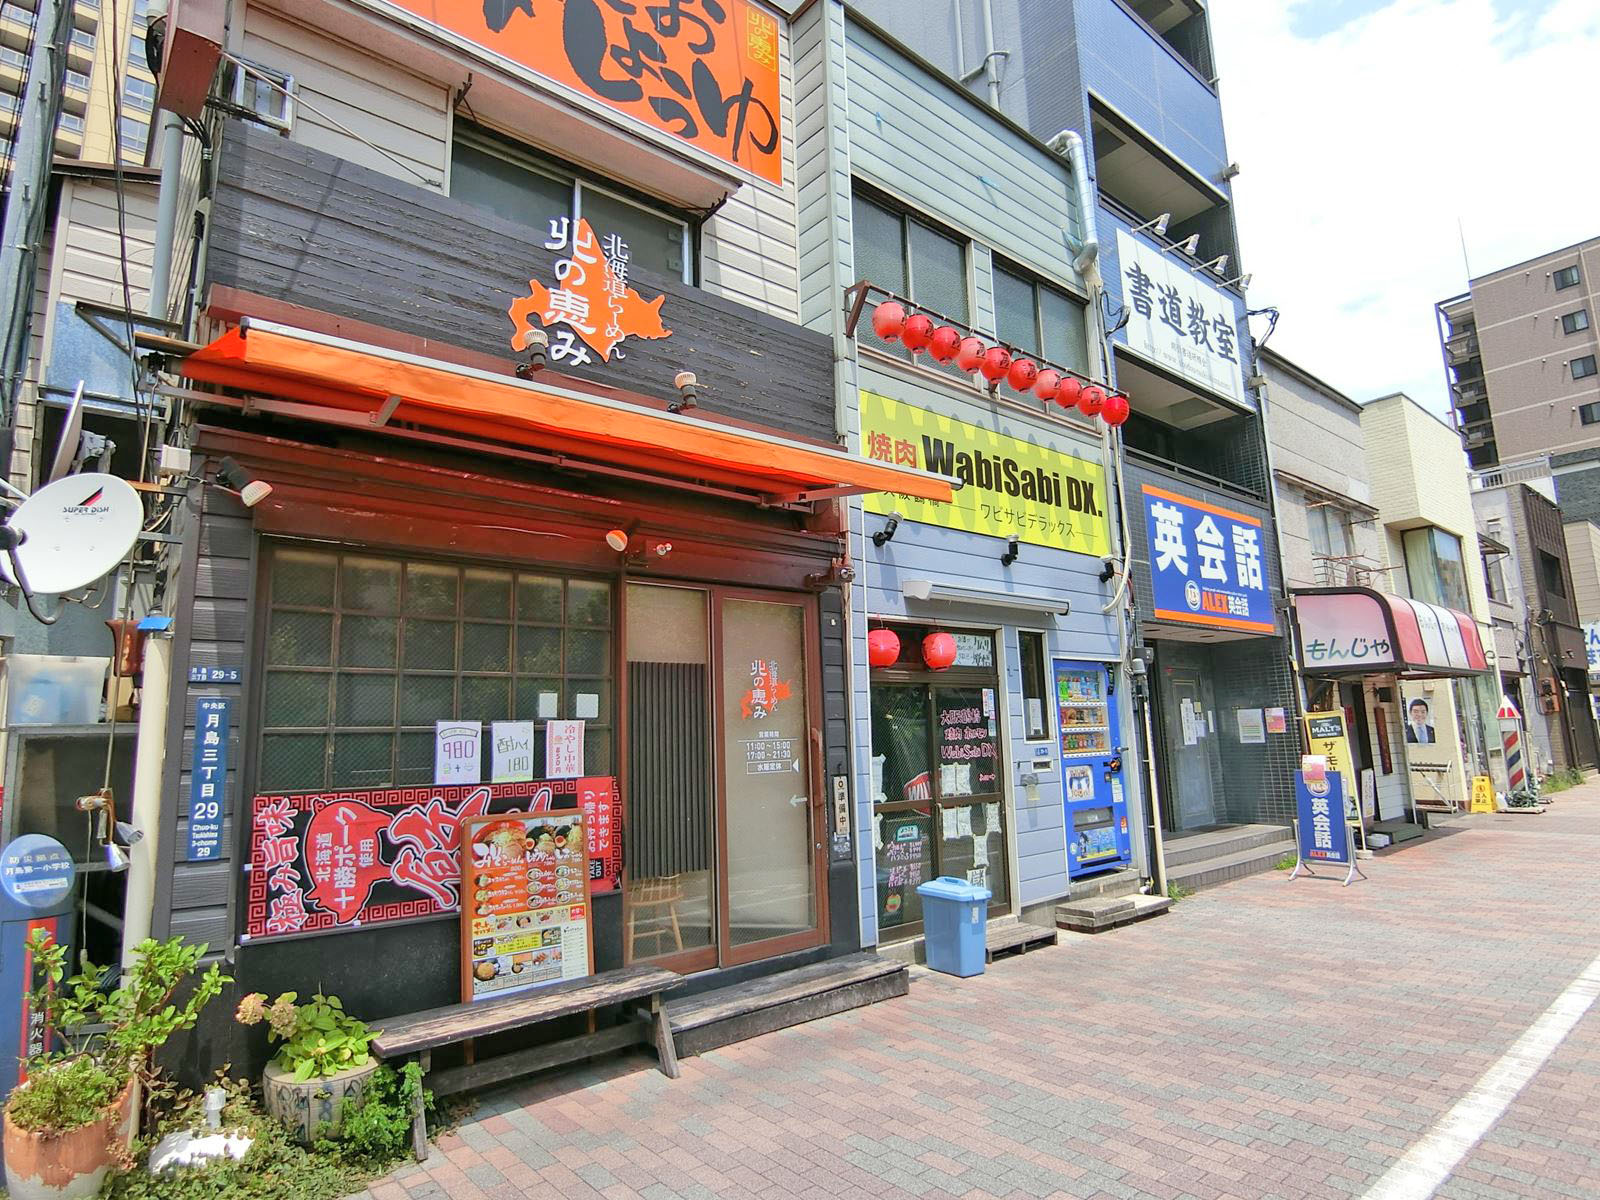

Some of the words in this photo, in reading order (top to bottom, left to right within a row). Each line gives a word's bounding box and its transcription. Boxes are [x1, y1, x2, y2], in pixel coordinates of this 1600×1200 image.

[544, 216, 598, 367] 北の恵み
[603, 233, 630, 360] 北海道らーめん
[1124, 260, 1238, 366] 書道教室
[867, 430, 918, 468] 焼肉
[921, 434, 1061, 509] WabiSabi
[63, 506, 89, 514] SUPER
[1150, 501, 1264, 592] 英会話
[211, 669, 239, 680] 29-5
[751, 659, 769, 719] 北の恵み
[202, 702, 226, 710] 中央区
[201, 713, 220, 798] 月島三丁目
[508, 756, 529, 772] 180
[194, 802, 219, 820] 29
[1311, 798, 1332, 849] 英会話
[196, 847, 211, 858] 29
[257, 798, 308, 930] 極み旨味
[316, 832, 333, 883] 北海道
[334, 806, 358, 909] 十勝ポーク
[359, 838, 374, 868] 使用
[28, 1012, 45, 1056] 消火器
